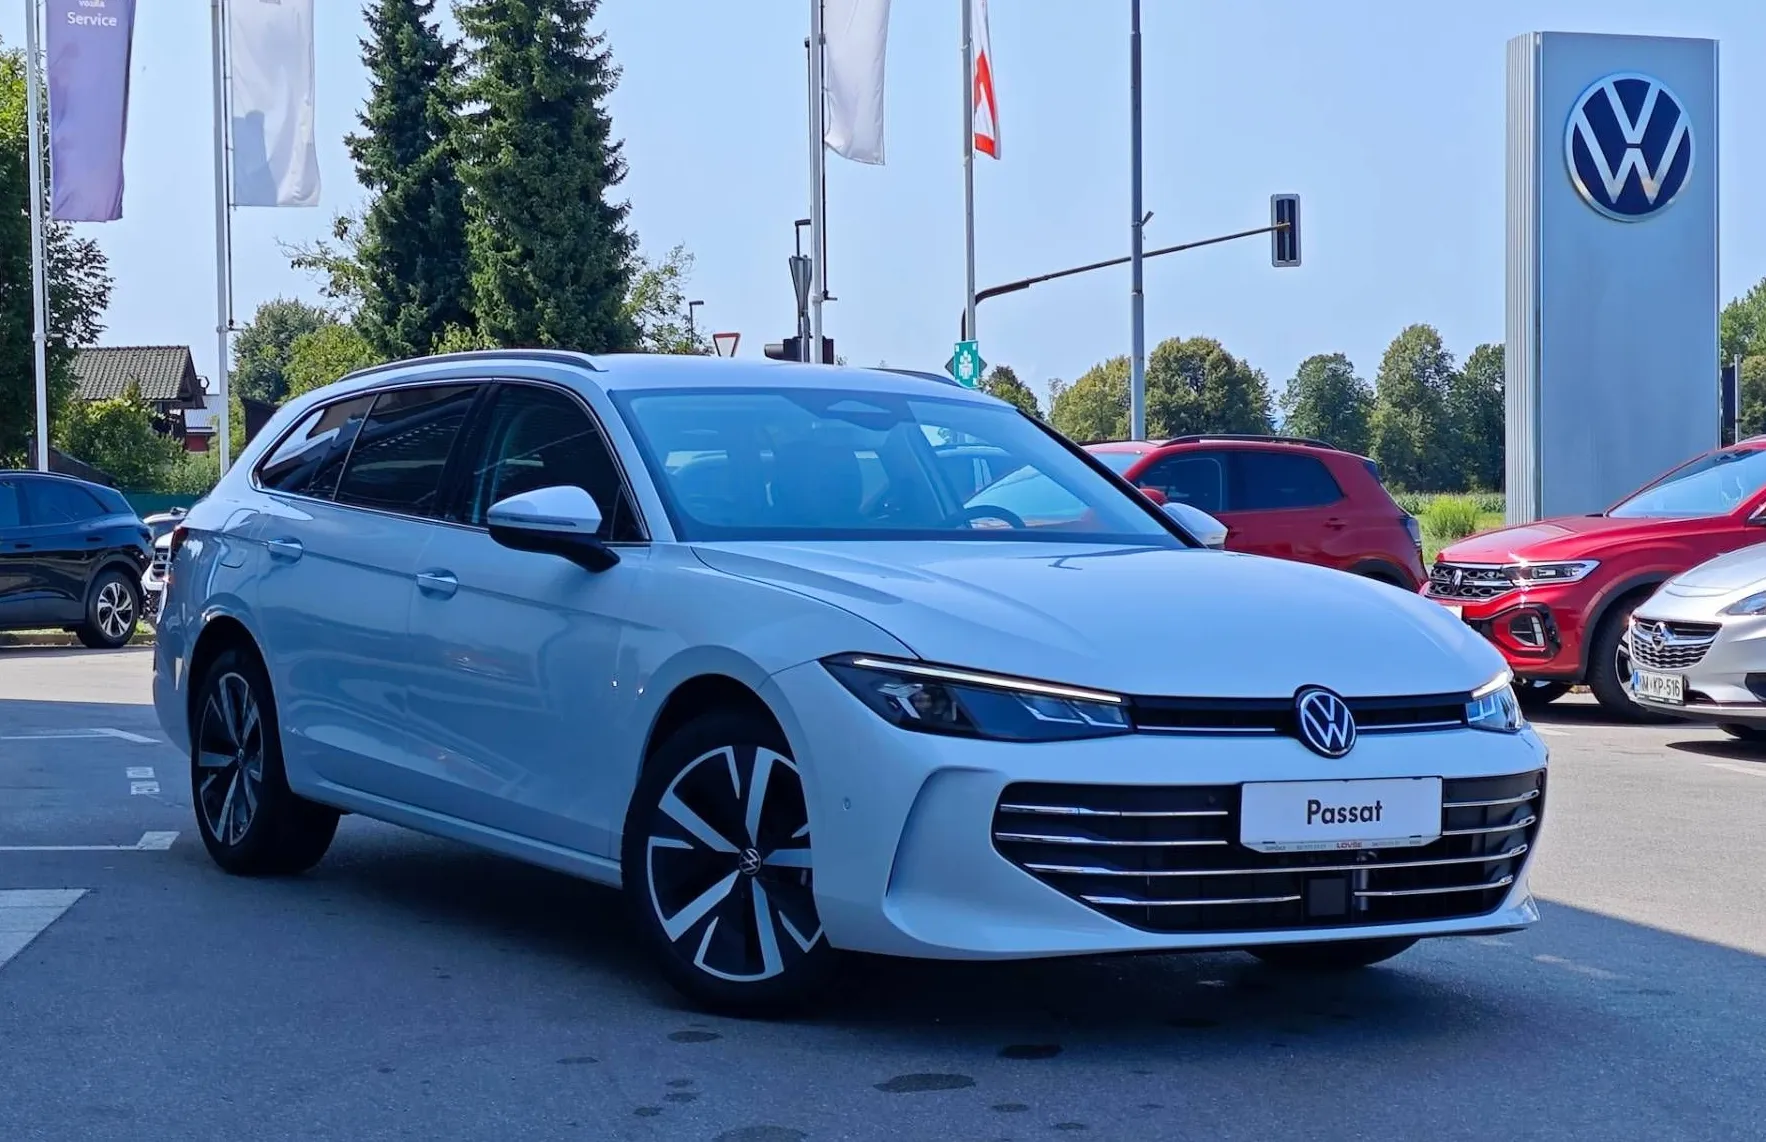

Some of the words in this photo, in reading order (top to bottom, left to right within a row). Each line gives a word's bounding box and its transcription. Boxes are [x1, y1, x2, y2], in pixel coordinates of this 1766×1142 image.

[67, 11, 117, 27] Service
[1565, 72, 1696, 222] VW
[1300, 691, 1356, 756] VW
[1306, 799, 1383, 825] Passat
